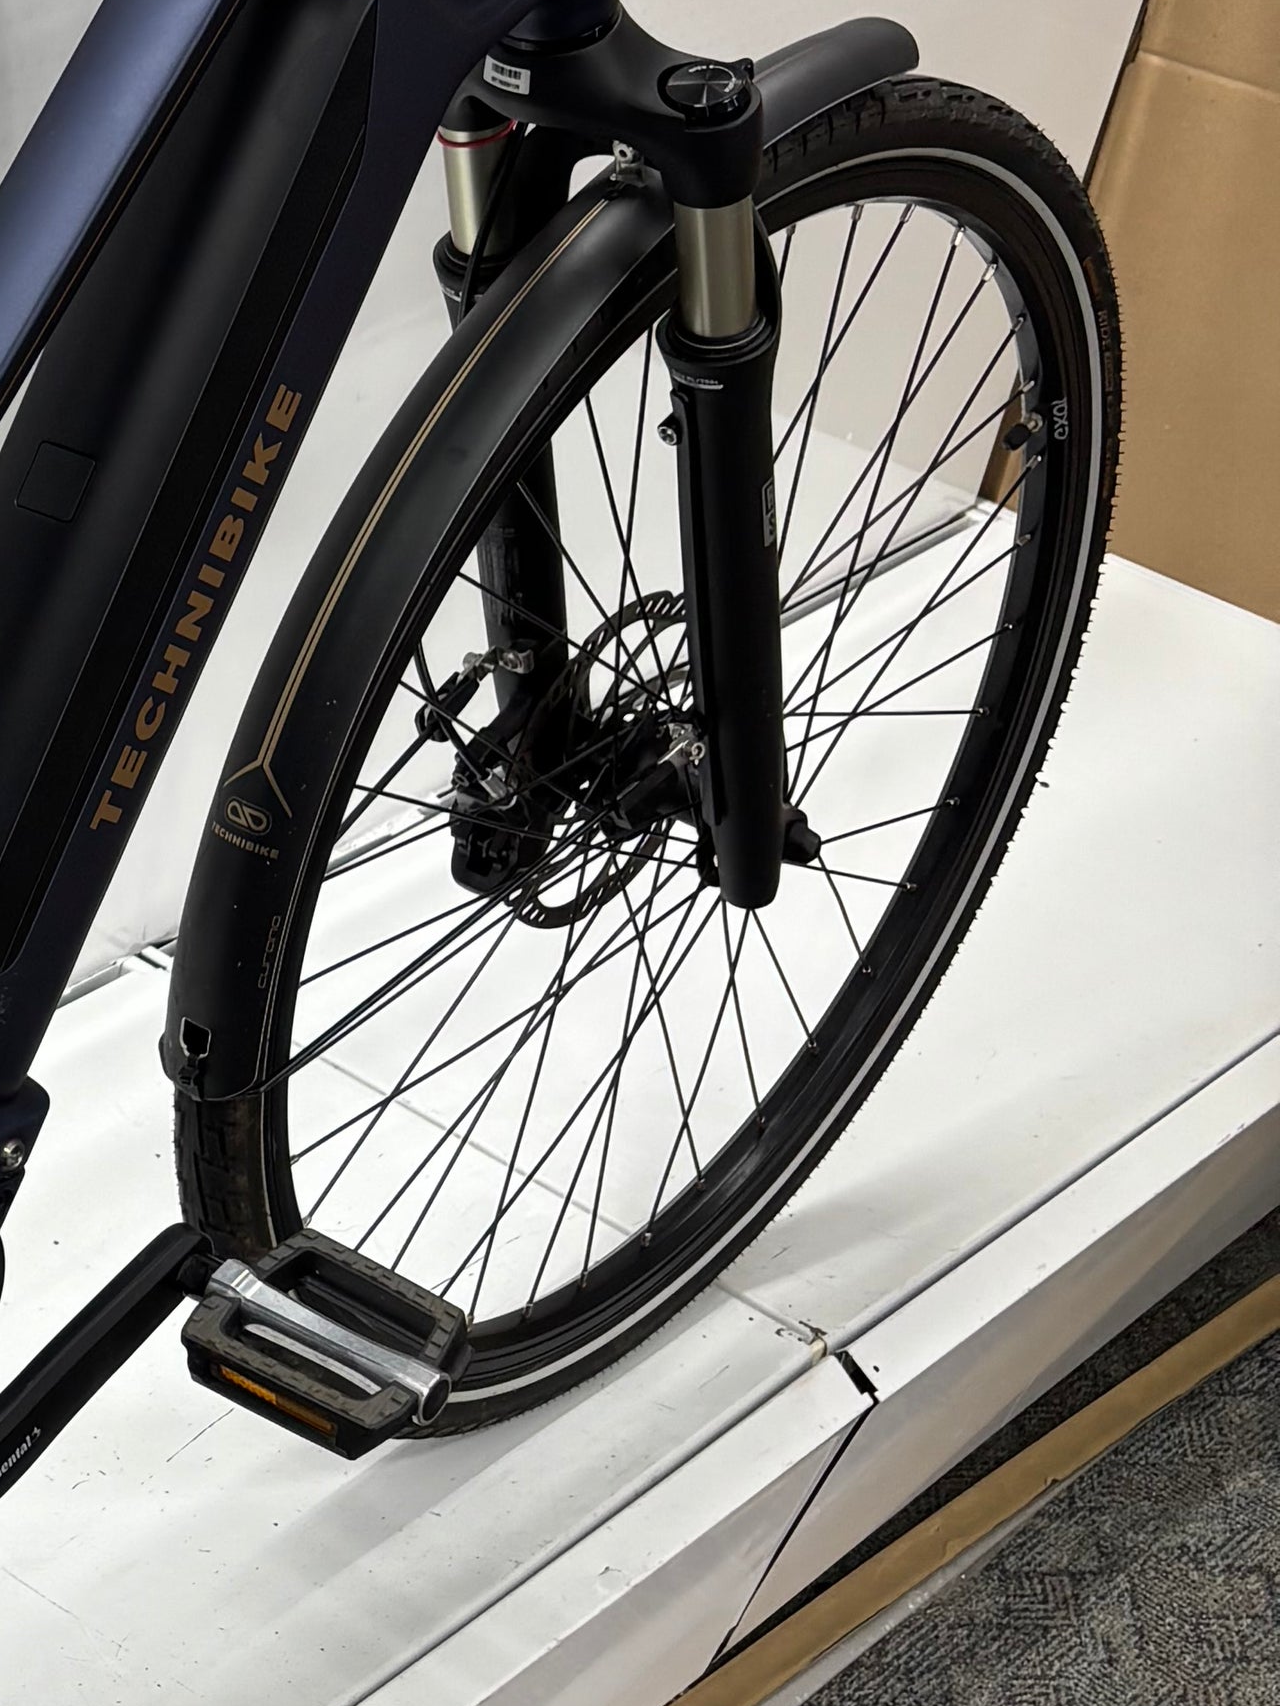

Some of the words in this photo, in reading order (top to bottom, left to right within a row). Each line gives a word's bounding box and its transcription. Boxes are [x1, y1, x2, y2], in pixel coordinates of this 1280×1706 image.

[1051, 394, 1068, 440] exal
[89, 383, 303, 831] TECHNIBIKE
[212, 821, 280, 860] TECHNIBIKE
